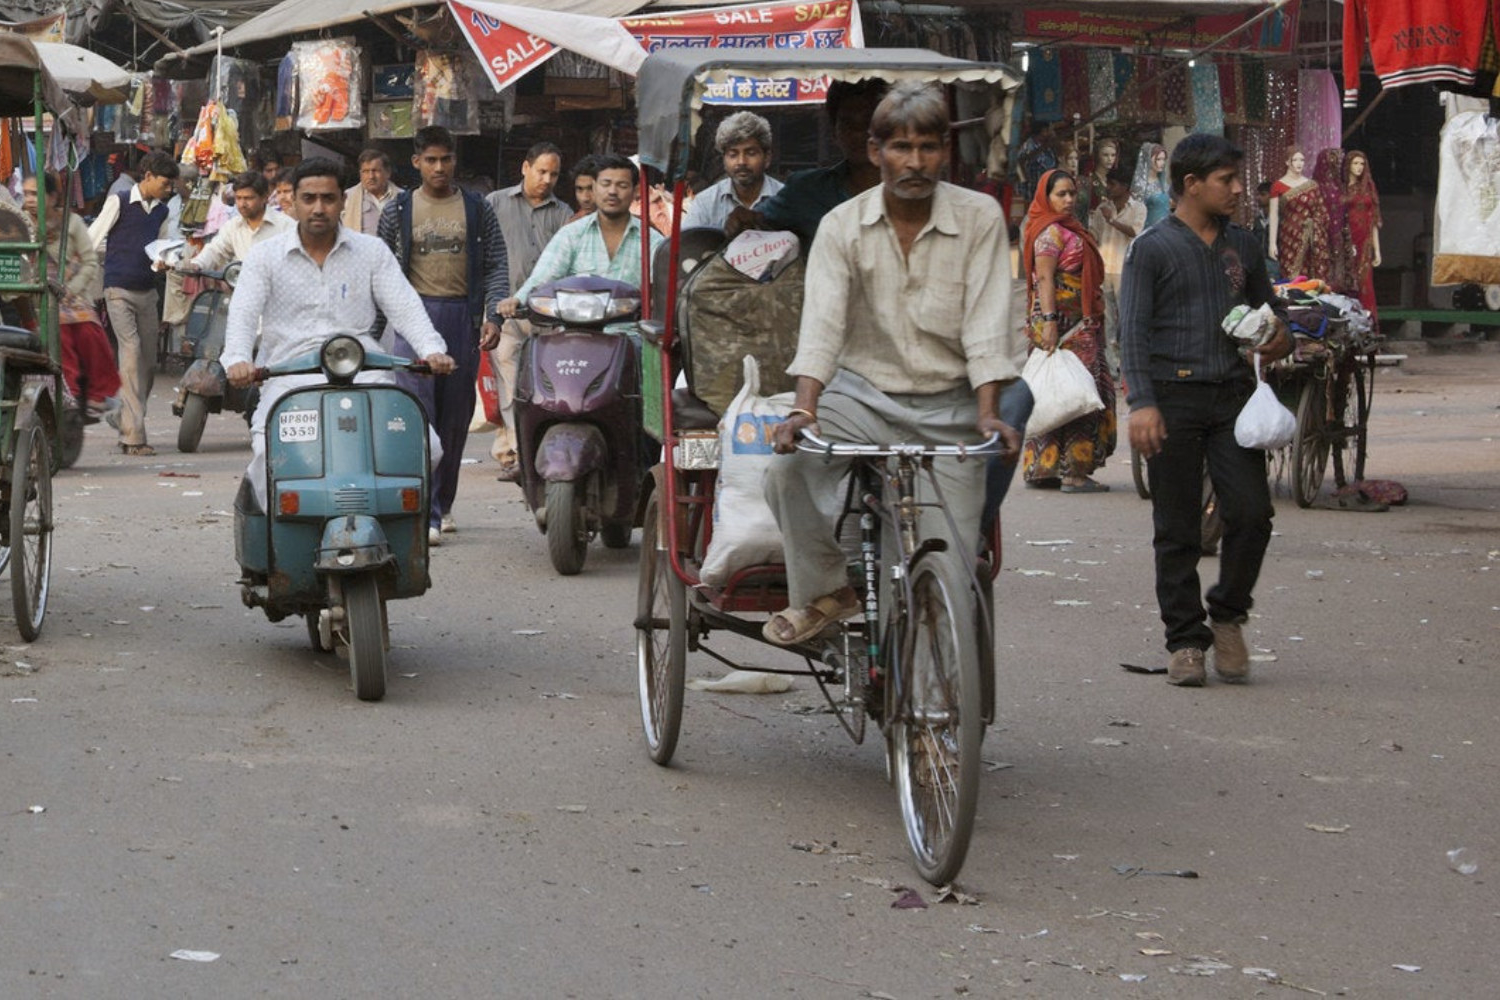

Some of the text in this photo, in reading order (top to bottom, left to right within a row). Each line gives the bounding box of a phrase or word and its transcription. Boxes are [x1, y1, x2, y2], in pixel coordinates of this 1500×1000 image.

[714, 8, 773, 25] SALE
[795, 0, 848, 21] SALE
[491, 32, 547, 76] SALE
[800, 75, 833, 94] SA
[864, 551, 879, 614] NEELAM
